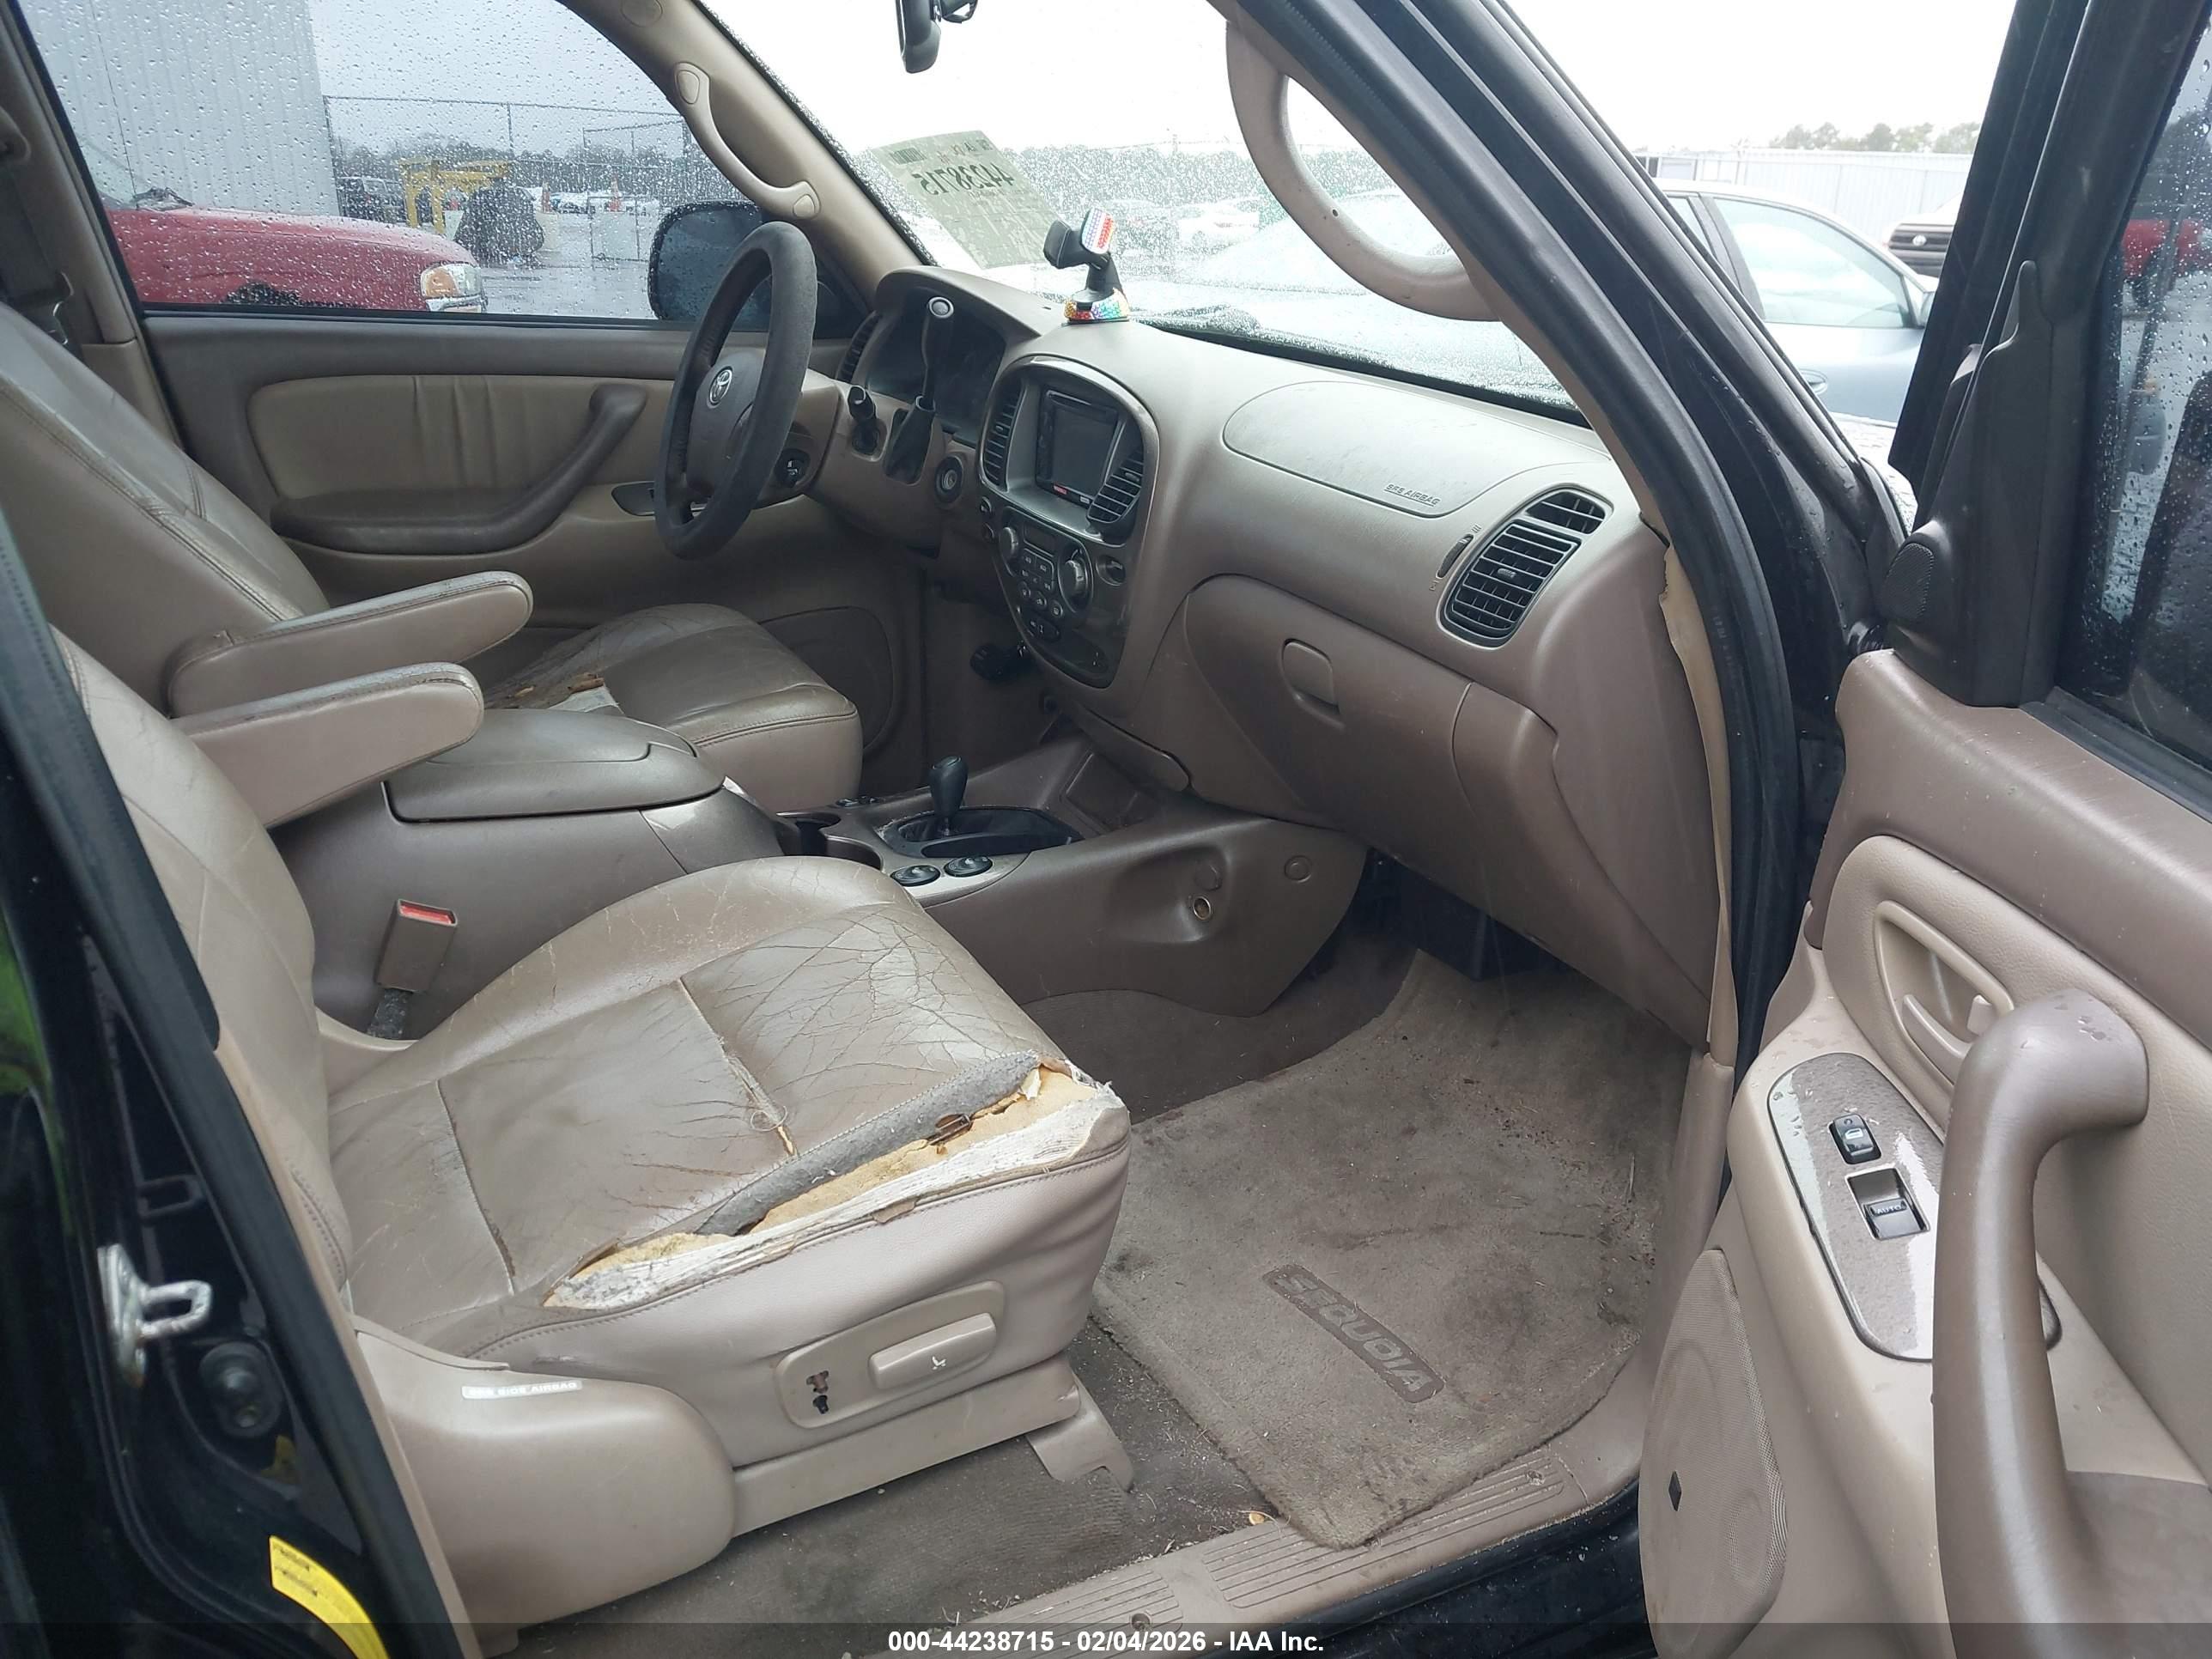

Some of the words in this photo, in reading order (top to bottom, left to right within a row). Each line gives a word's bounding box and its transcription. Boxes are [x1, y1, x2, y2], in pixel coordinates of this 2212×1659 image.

[1385, 483, 1404, 495] SRS
[1404, 490, 1441, 505] AIRBAG
[1876, 1205, 1902, 1215] AUTO
[1273, 1273, 1433, 1392] SEQUOIA
[530, 1382, 578, 1394] AIRBAG
